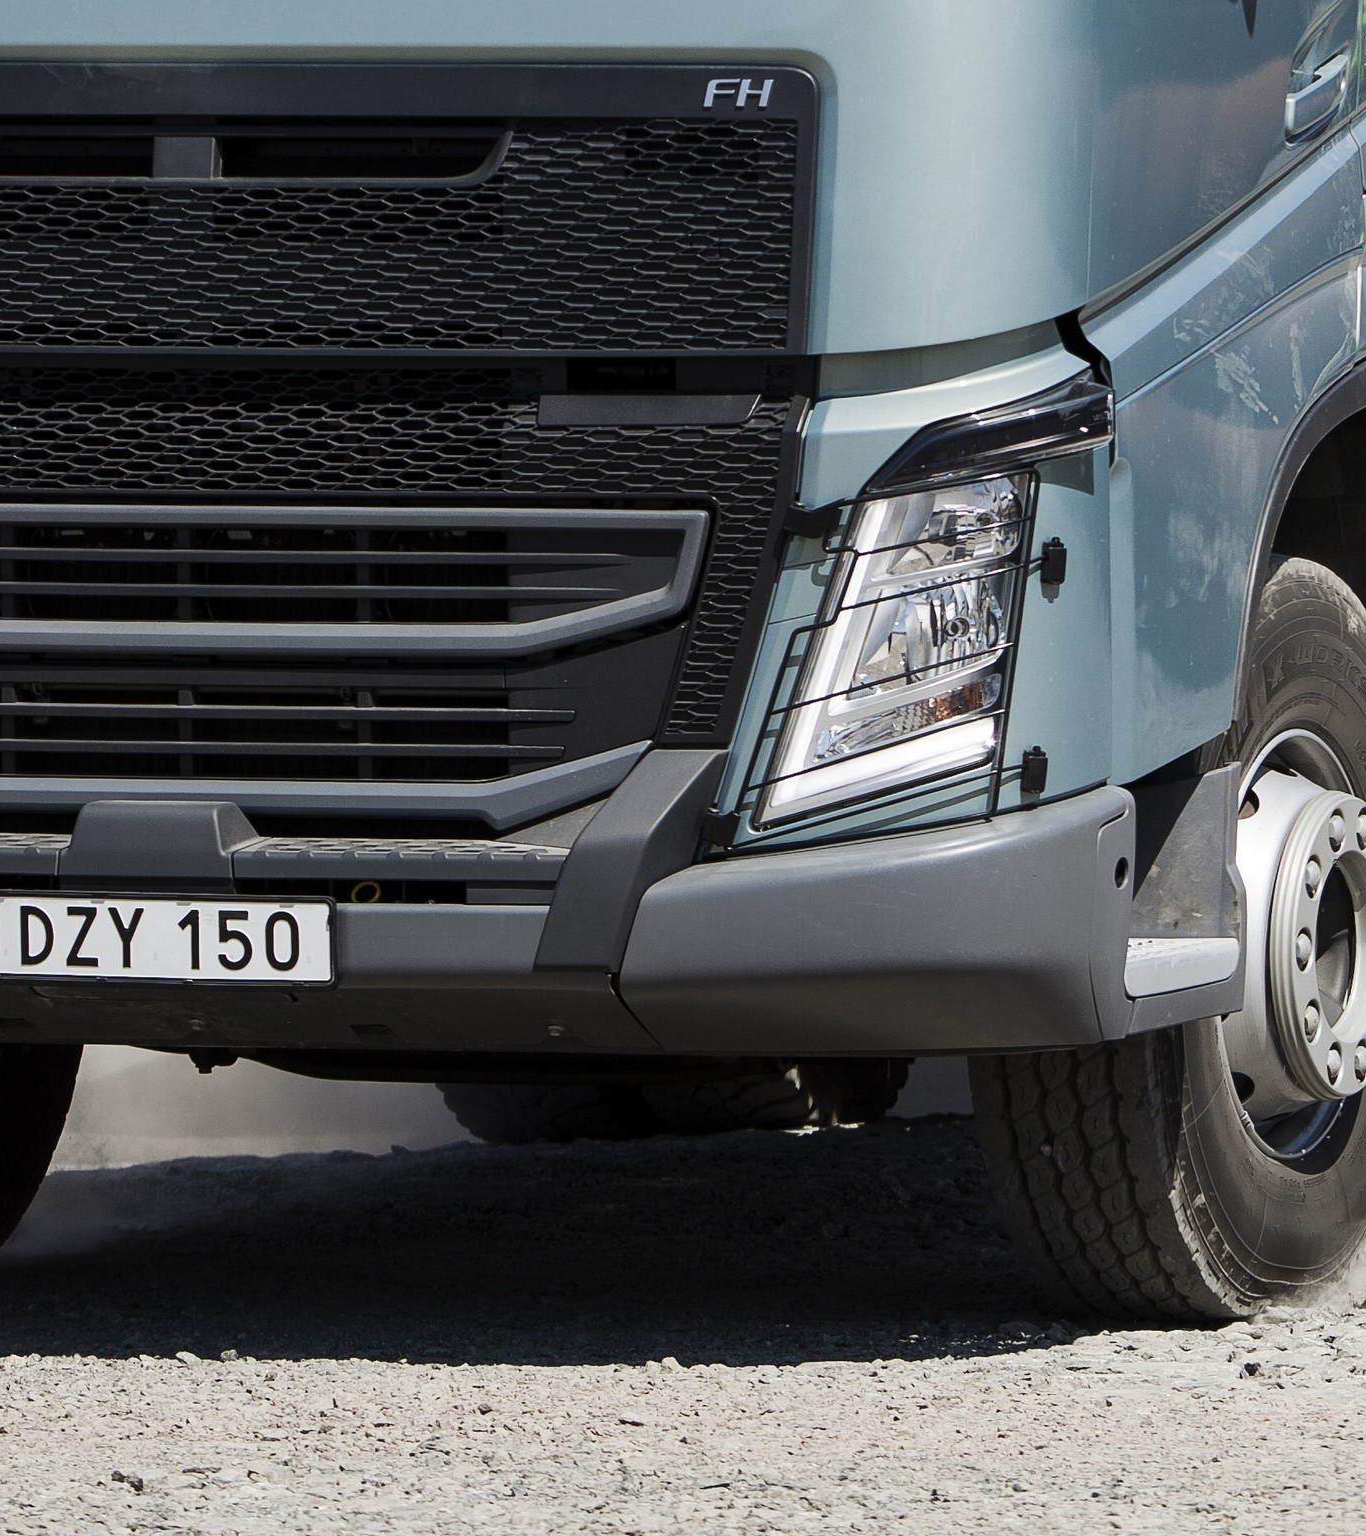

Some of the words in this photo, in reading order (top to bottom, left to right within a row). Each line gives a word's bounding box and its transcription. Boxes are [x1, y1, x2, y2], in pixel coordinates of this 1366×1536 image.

[703, 78, 774, 107] FH
[19, 905, 145, 969] DZY
[177, 908, 301, 972] 150
